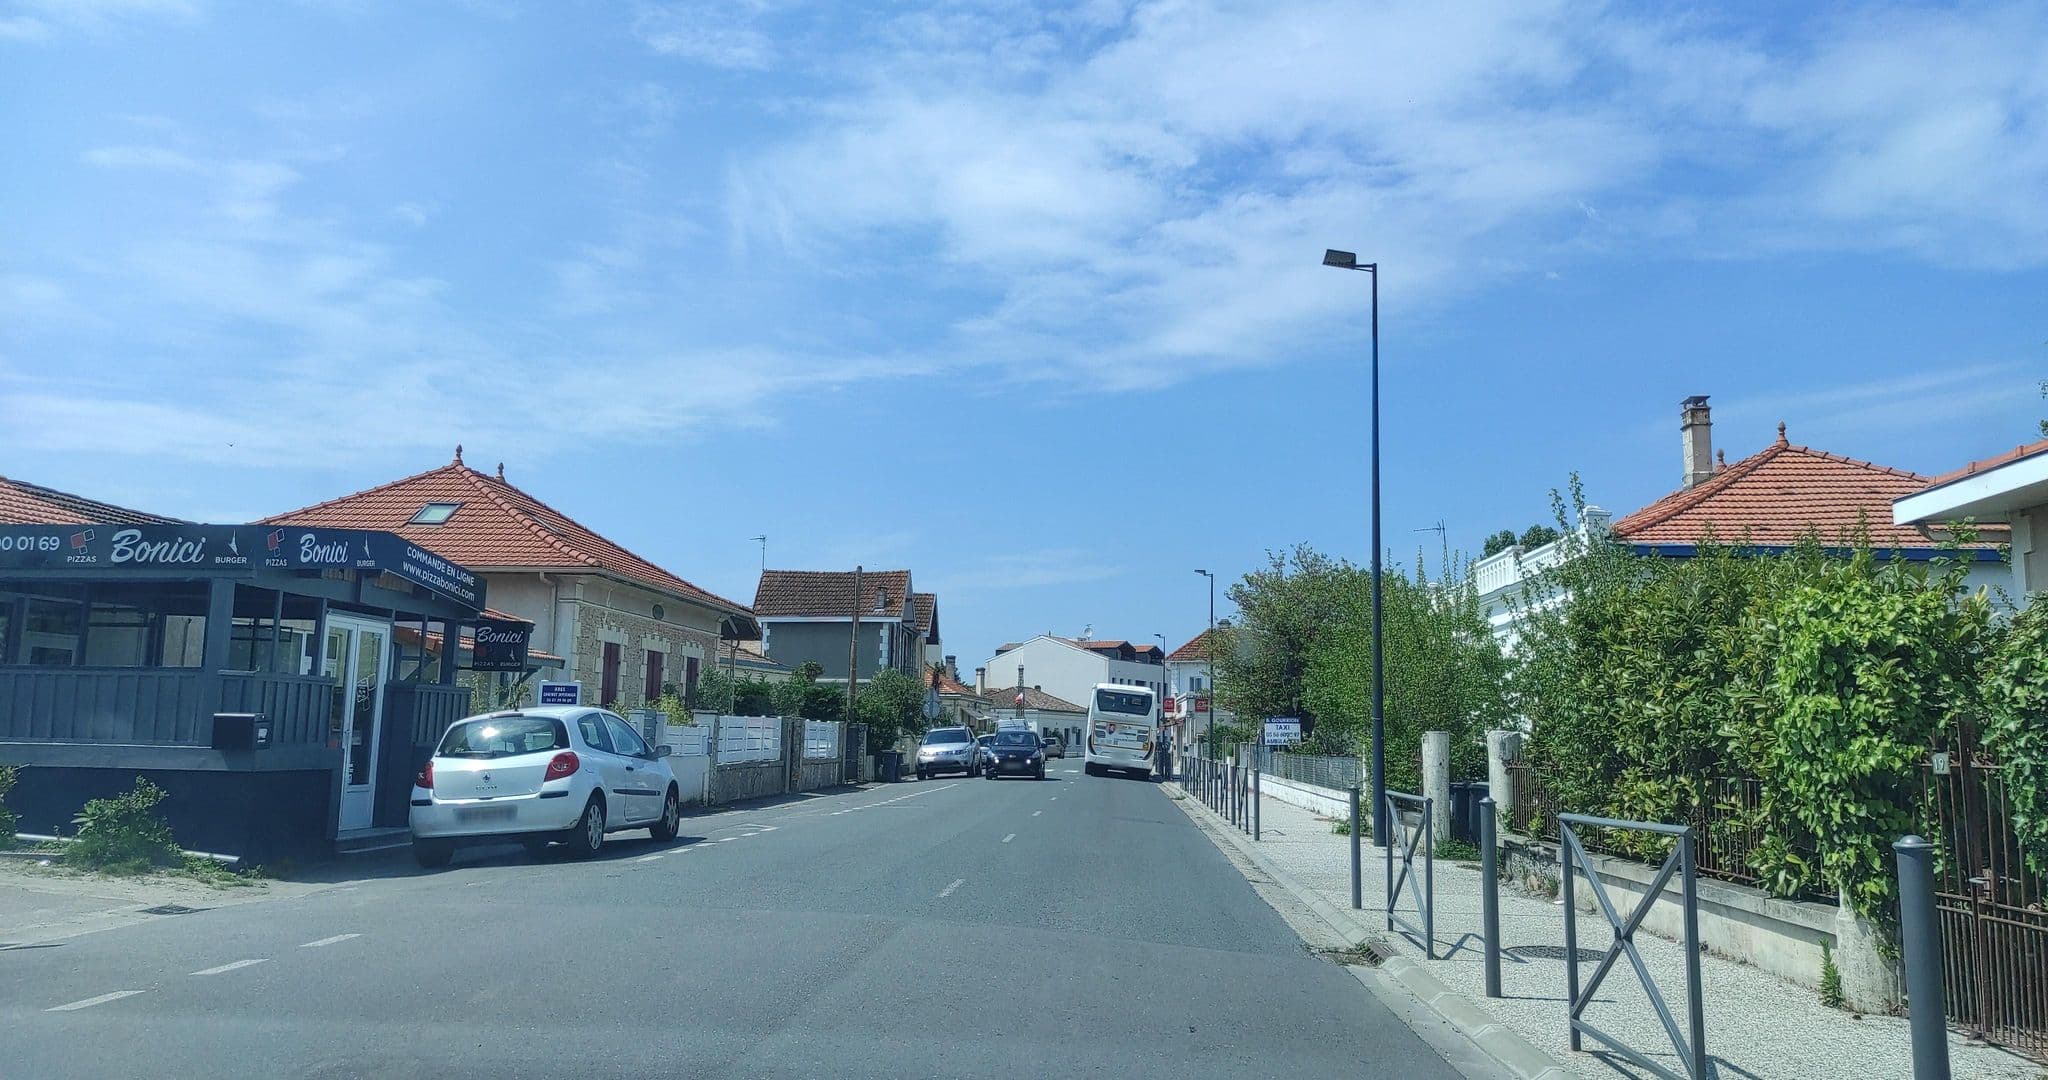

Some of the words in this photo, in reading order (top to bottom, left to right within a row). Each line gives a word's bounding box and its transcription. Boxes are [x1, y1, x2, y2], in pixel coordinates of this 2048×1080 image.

[0, 535, 13, 551] 0
[16, 535, 35, 551] 01
[38, 535, 61, 551] 69
[110, 528, 206, 563] Bonici
[299, 533, 349, 563] Bonici
[215, 556, 247, 564] BURGER
[265, 558, 288, 567] PIZZAS
[356, 559, 376, 567] BURGER
[406, 546, 446, 573] COMMANDE
[446, 565, 456, 579] EN
[456, 569, 475, 587] LIGNE
[402, 561, 475, 602] www.pizzabonici.com
[476, 626, 524, 644] Bonici
[1934, 758, 1945, 770] 19
